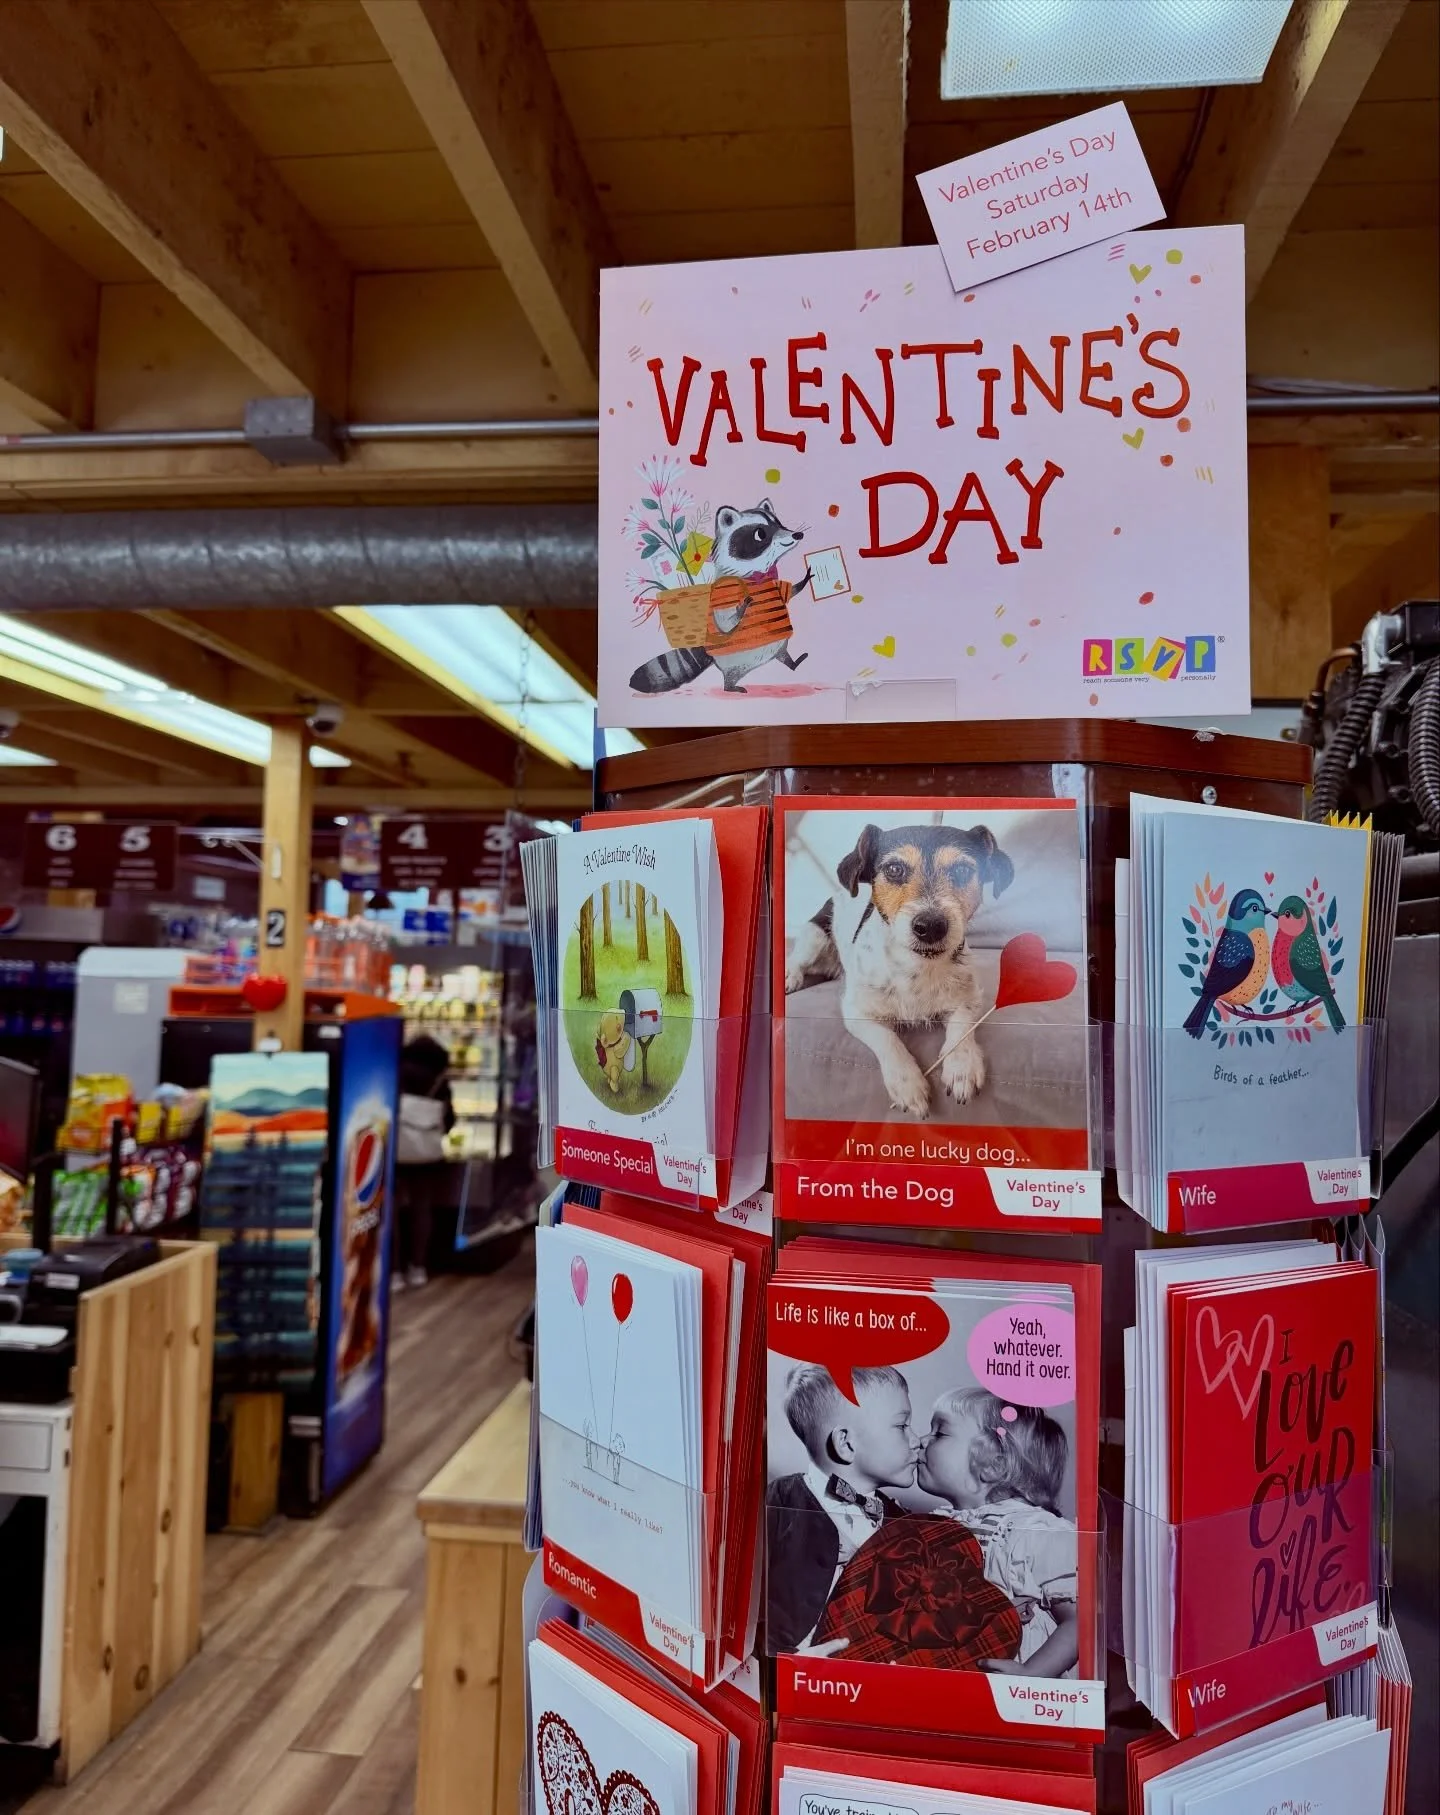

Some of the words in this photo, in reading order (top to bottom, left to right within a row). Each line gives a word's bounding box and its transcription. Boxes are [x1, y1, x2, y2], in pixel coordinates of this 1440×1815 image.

[938, 148, 1064, 203] Valentine's
[1070, 131, 1116, 157] Day
[987, 173, 1089, 219] Saturday
[966, 212, 1070, 259] February
[1078, 188, 1132, 218] 14th
[647, 313, 1190, 466] VALENTINE'S
[858, 458, 1064, 564] DAY
[46, 824, 77, 851] 6
[398, 823, 428, 849] 4
[483, 825, 514, 851] 3
[584, 855, 594, 875] A
[592, 846, 631, 868] Valentine
[632, 844, 656, 870] Wish
[267, 911, 286, 946] 2
[1213, 1065, 1238, 1084] Birds
[1243, 1075, 1253, 1085] of
[1258, 1077, 1264, 1086] a
[561, 1139, 610, 1165] Someone
[613, 1151, 654, 1175] Special
[663, 1155, 707, 1175] Valentine's
[846, 1139, 874, 1157] I'm
[880, 1142, 915, 1158] one
[921, 1140, 970, 1164] lucky
[976, 1142, 1031, 1165] dog...
[677, 1171, 693, 1187] Day
[797, 1176, 853, 1199] From
[861, 1178, 898, 1200] the
[906, 1181, 954, 1207] Dog
[1007, 1179, 1086, 1194] Valentine's
[1332, 1183, 1349, 1196] Day
[1032, 1195, 1060, 1212] Day
[1179, 1184, 1217, 1207] Wife
[732, 1207, 749, 1224] Day
[776, 1302, 802, 1322] Life
[807, 1304, 818, 1324] is
[824, 1306, 850, 1326] like
[855, 1311, 863, 1327] a
[869, 1309, 895, 1329] box
[900, 1311, 927, 1332] of...
[1009, 1317, 1046, 1339] Yeah,
[993, 1338, 1063, 1358] whatever.
[1279, 1328, 1295, 1365] I
[986, 1358, 1021, 1378] Hand
[1025, 1360, 1035, 1378] it
[1039, 1364, 1071, 1380] over.
[620, 1507, 642, 1525] really
[548, 1551, 597, 1599] Romantic
[650, 1612, 695, 1648] Valentine's
[663, 1635, 680, 1657] Day
[1340, 1637, 1357, 1651] Day
[793, 1671, 862, 1702] Funny
[1009, 1685, 1089, 1704] Valentine's
[1188, 1678, 1227, 1708] Wife
[1033, 1703, 1063, 1721] Day
[805, 1800, 841, 1815] You've
